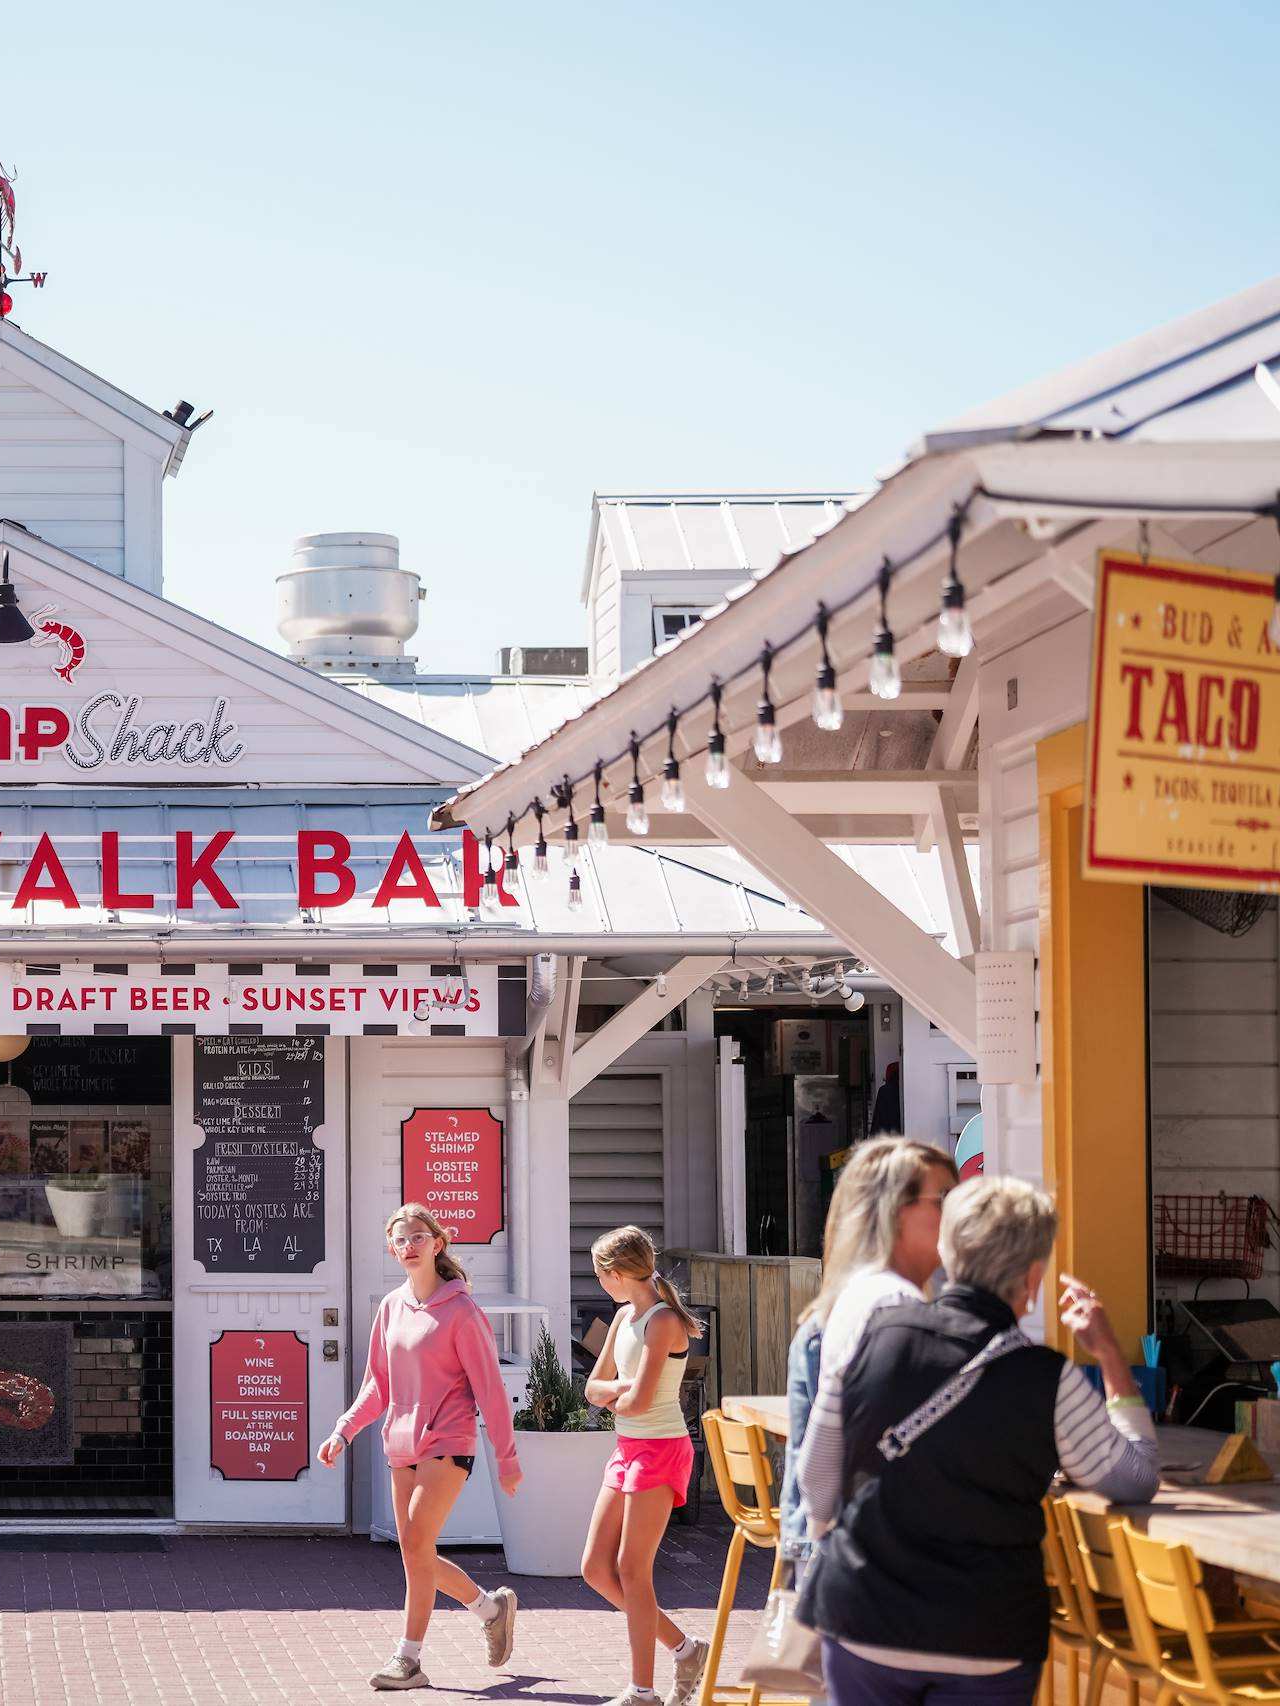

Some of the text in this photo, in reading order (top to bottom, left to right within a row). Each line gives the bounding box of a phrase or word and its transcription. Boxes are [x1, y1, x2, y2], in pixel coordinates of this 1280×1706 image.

[1163, 604, 1213, 646] BUD
[1227, 615, 1243, 649] &
[1121, 664, 1260, 753] TACO
[66, 694, 244, 768] Shack
[1212, 780, 1272, 807] TEQUILA
[13, 987, 118, 1011] DRAFT
[130, 987, 211, 1011] BEER
[242, 987, 367, 1011] SUNSET
[379, 988, 481, 1012] VIEWS
[204, 1046, 228, 1054] PROTEIN
[229, 1046, 248, 1054] PLATE
[239, 1063, 272, 1076] KIDS
[235, 1106, 281, 1119] DESSERT
[203, 1118, 215, 1126] KEY
[216, 1118, 231, 1126] LIME
[424, 1132, 480, 1142] STEAMED
[216, 1143, 243, 1155] FRESH
[251, 1143, 295, 1155] OYSTERS
[429, 1143, 475, 1154] SHRIMP
[206, 1166, 236, 1174] PARMESAN
[426, 1162, 479, 1172] LOBSTER
[433, 1173, 472, 1183] ROLLS
[205, 1191, 320, 1201] OYSTER TRIO 38
[427, 1191, 479, 1201] OYSTERS
[197, 1203, 315, 1219] TODAY'S OYSTERS ARE
[431, 1209, 476, 1219] GUMBO
[235, 1220, 269, 1234] FROM:
[207, 1236, 303, 1252] TX LA AL
[25, 1252, 125, 1271] SHRIMP
[244, 1358, 274, 1368] WINE
[237, 1375, 281, 1385] FROZEN
[239, 1387, 280, 1396] DRINKS
[222, 1410, 298, 1420] FULL SERVICE
[246, 1422, 273, 1430] AT THE
[225, 1431, 295, 1441] BOARDWALK
[249, 1443, 271, 1452] BAR
